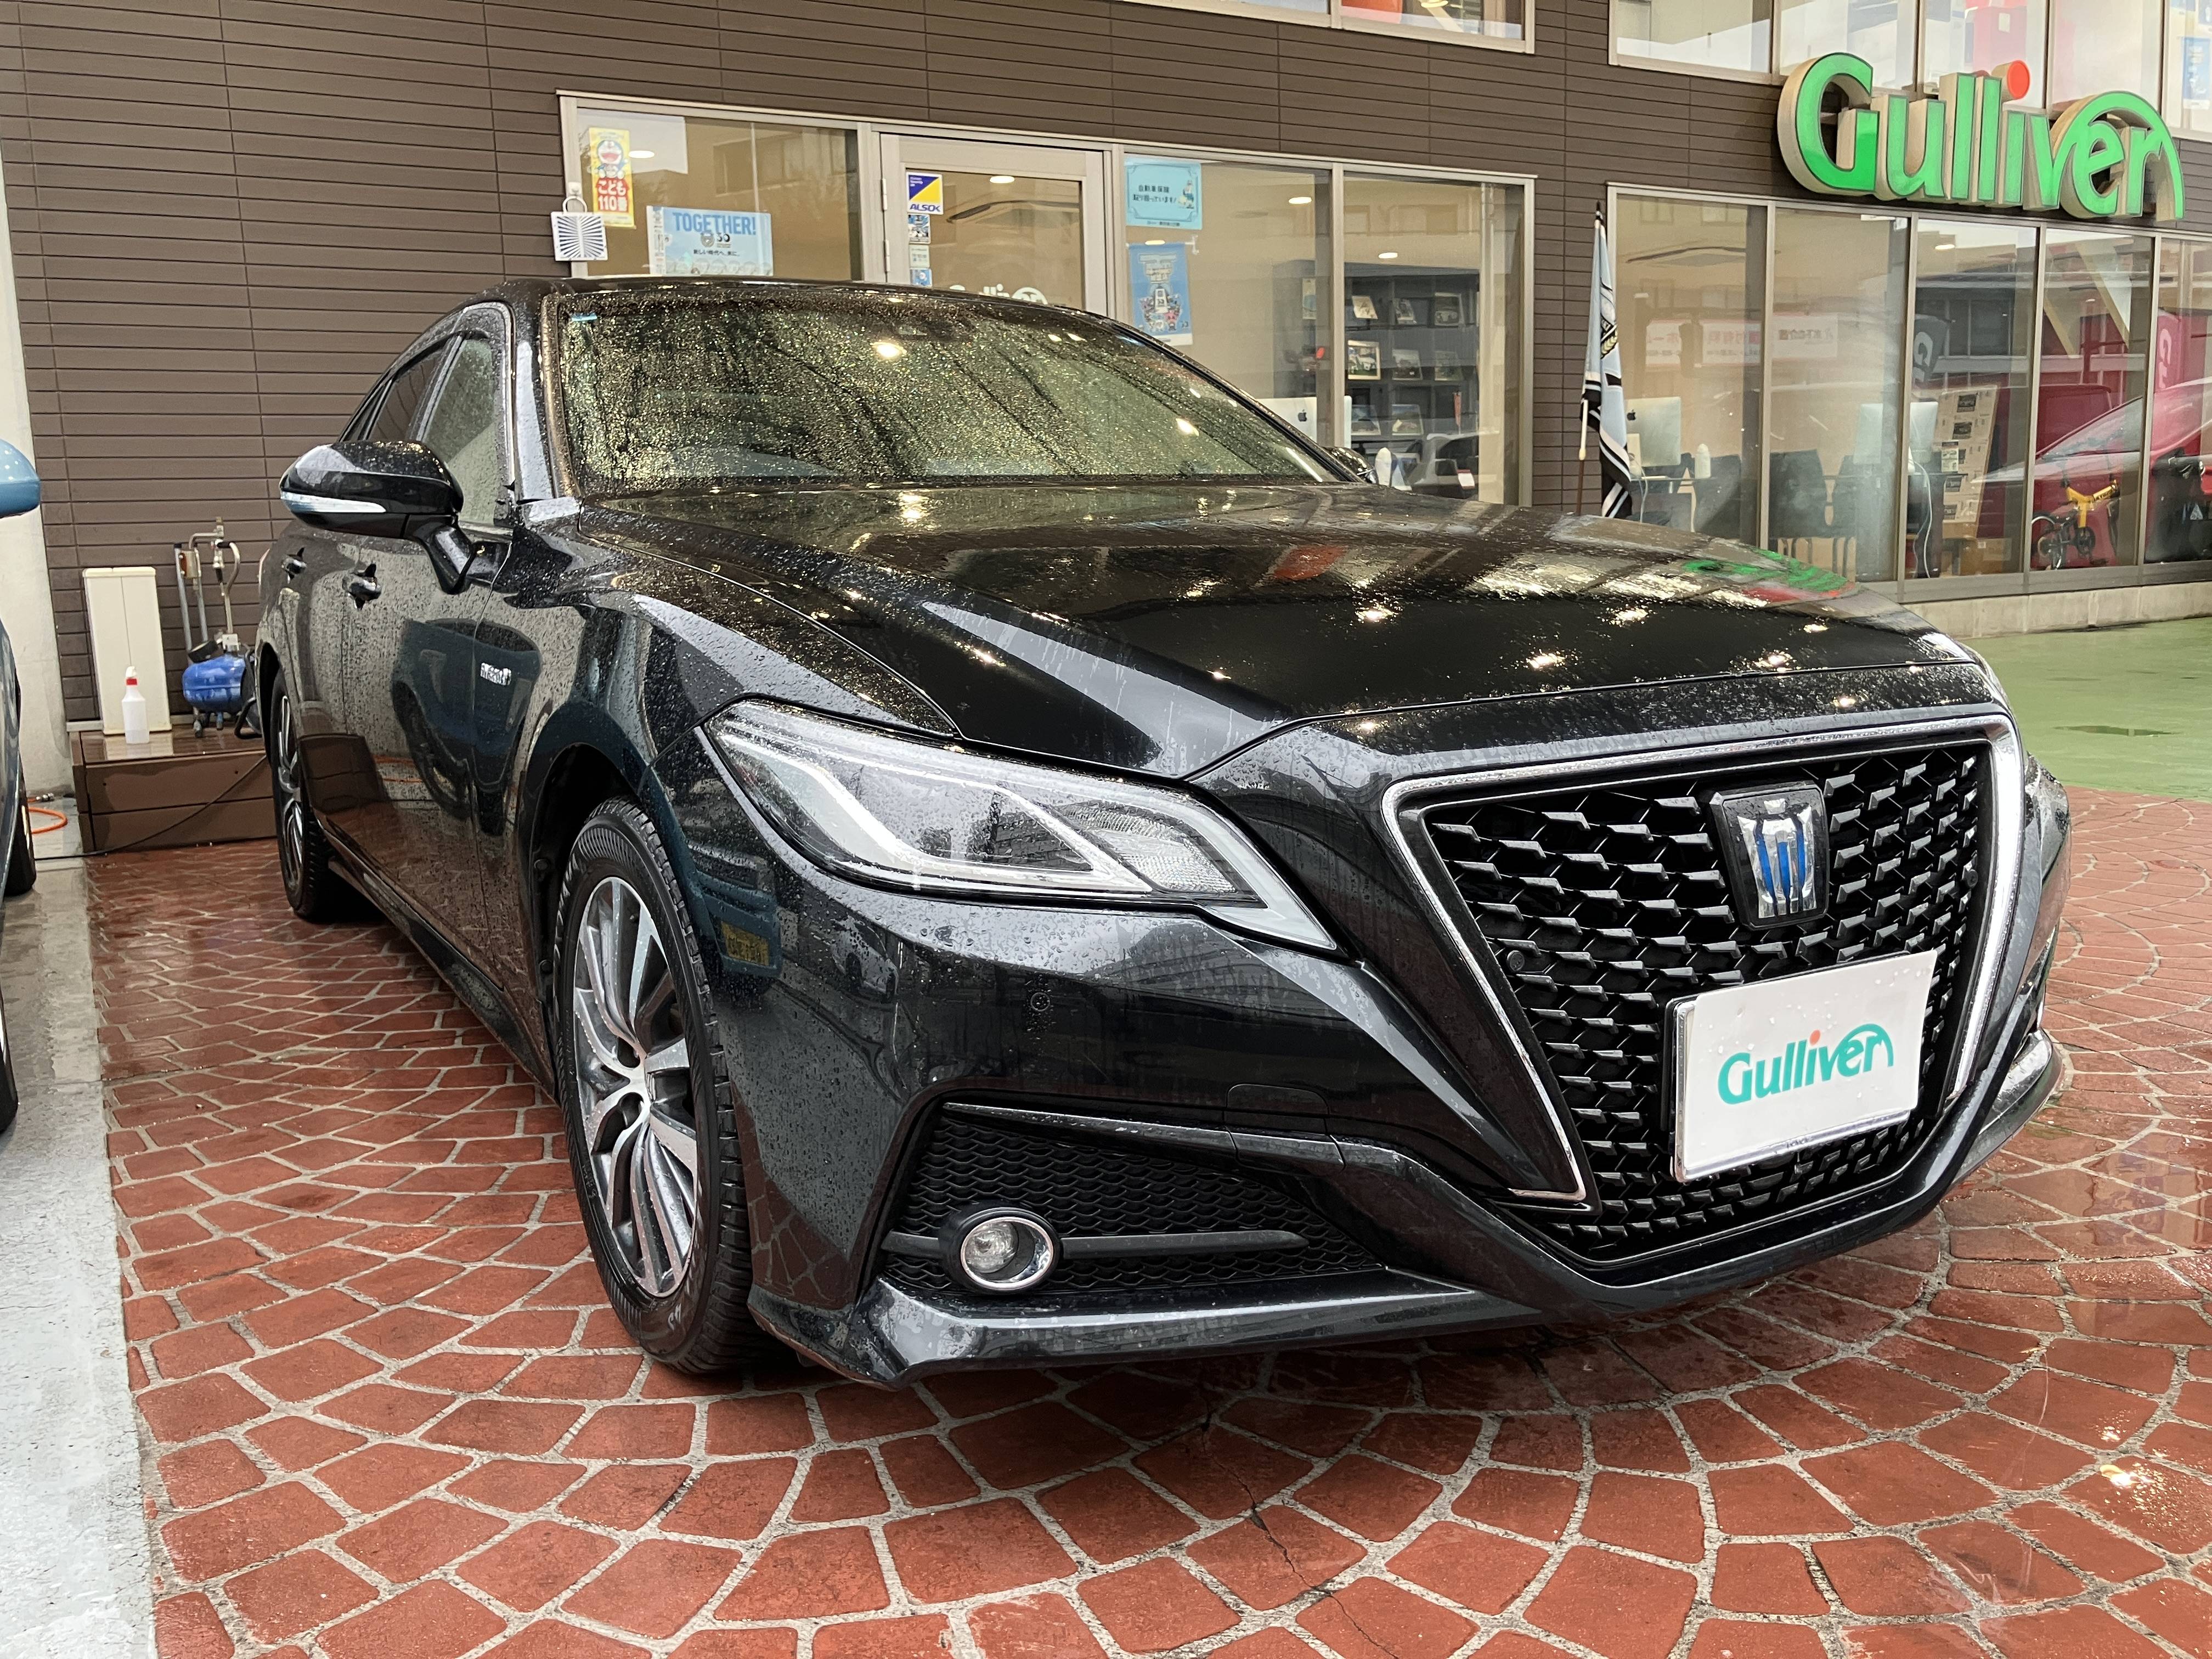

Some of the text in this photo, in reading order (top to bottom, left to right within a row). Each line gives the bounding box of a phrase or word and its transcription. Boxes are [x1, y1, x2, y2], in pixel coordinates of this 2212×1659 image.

[1778, 52, 2186, 221] Gulliver
[598, 179, 627, 196] こども
[910, 204, 941, 212] ALSOK
[672, 212, 757, 235] TOGETHER!
[1718, 1023, 1894, 1105] Gulliver
